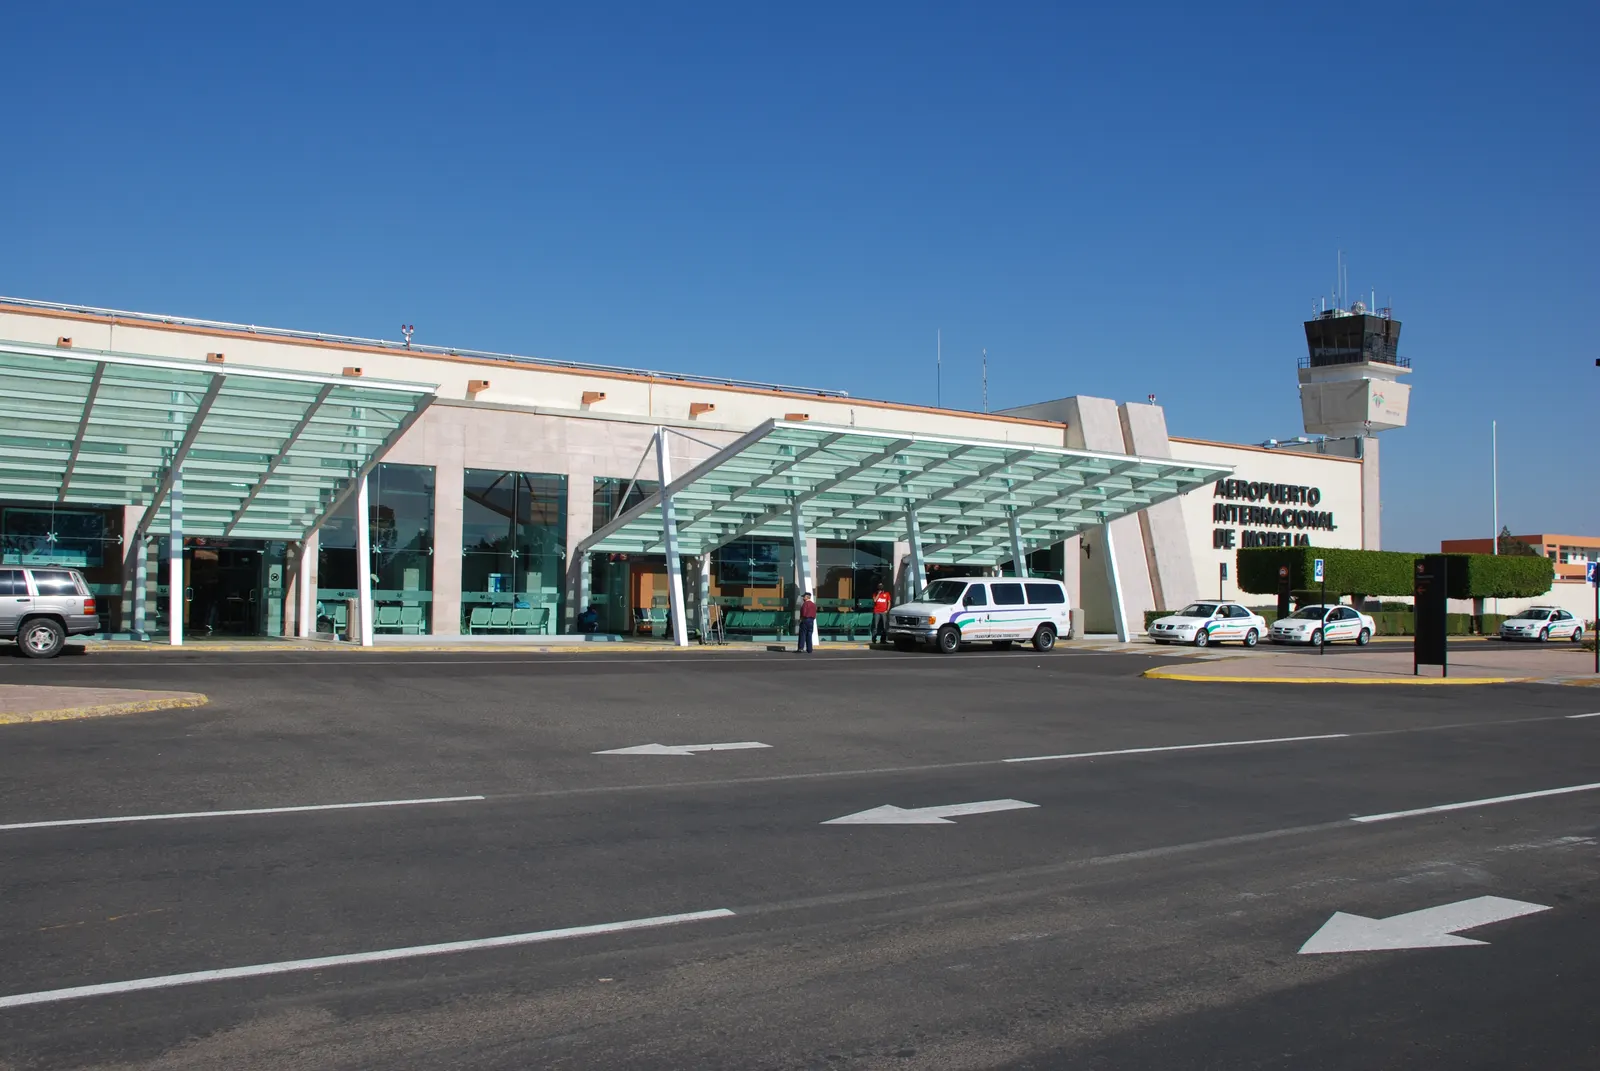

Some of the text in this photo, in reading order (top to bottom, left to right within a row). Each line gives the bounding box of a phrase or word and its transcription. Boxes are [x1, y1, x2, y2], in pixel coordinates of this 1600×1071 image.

[1213, 478, 1321, 507] AEROPUERTO
[1213, 503, 1338, 531] INTERNACIONAL
[1213, 528, 1236, 550] DE
